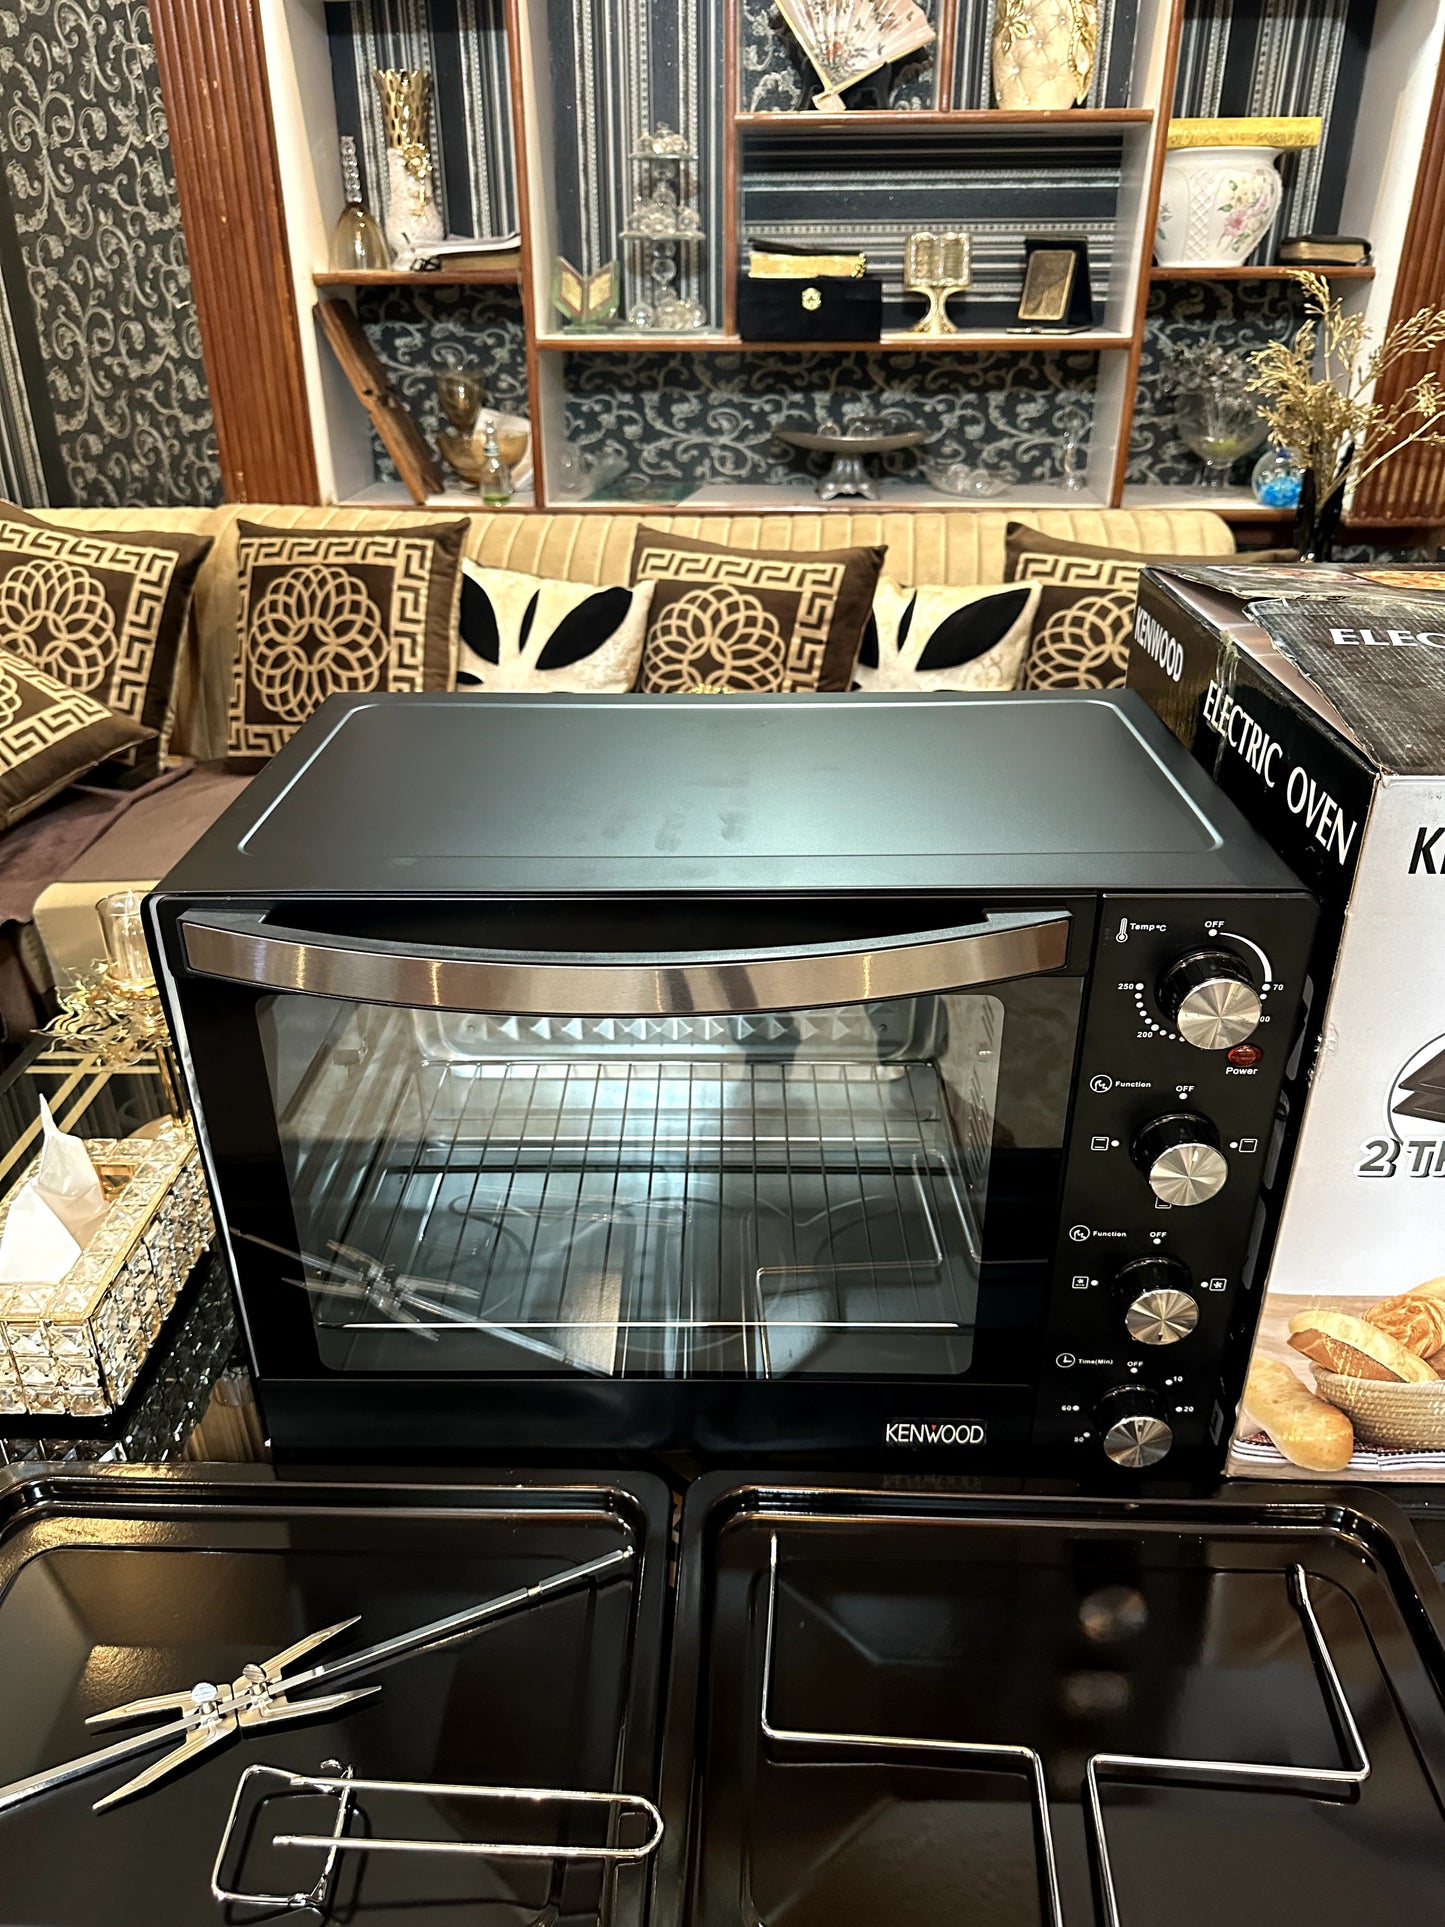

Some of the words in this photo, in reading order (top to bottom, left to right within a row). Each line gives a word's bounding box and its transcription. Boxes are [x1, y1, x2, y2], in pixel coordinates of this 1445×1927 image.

[1134, 605, 1184, 682] KENWOOD
[1202, 679, 1284, 789] ELECTRIC
[1286, 766, 1358, 866] OVEN
[1407, 826, 1445, 875] K
[1204, 920, 1225, 928] OFF
[1225, 1067, 1258, 1075] Power
[1357, 1137, 1398, 1177] 2
[1061, 1404, 1072, 1412] 60
[885, 1423, 984, 1443] KENWOOD
